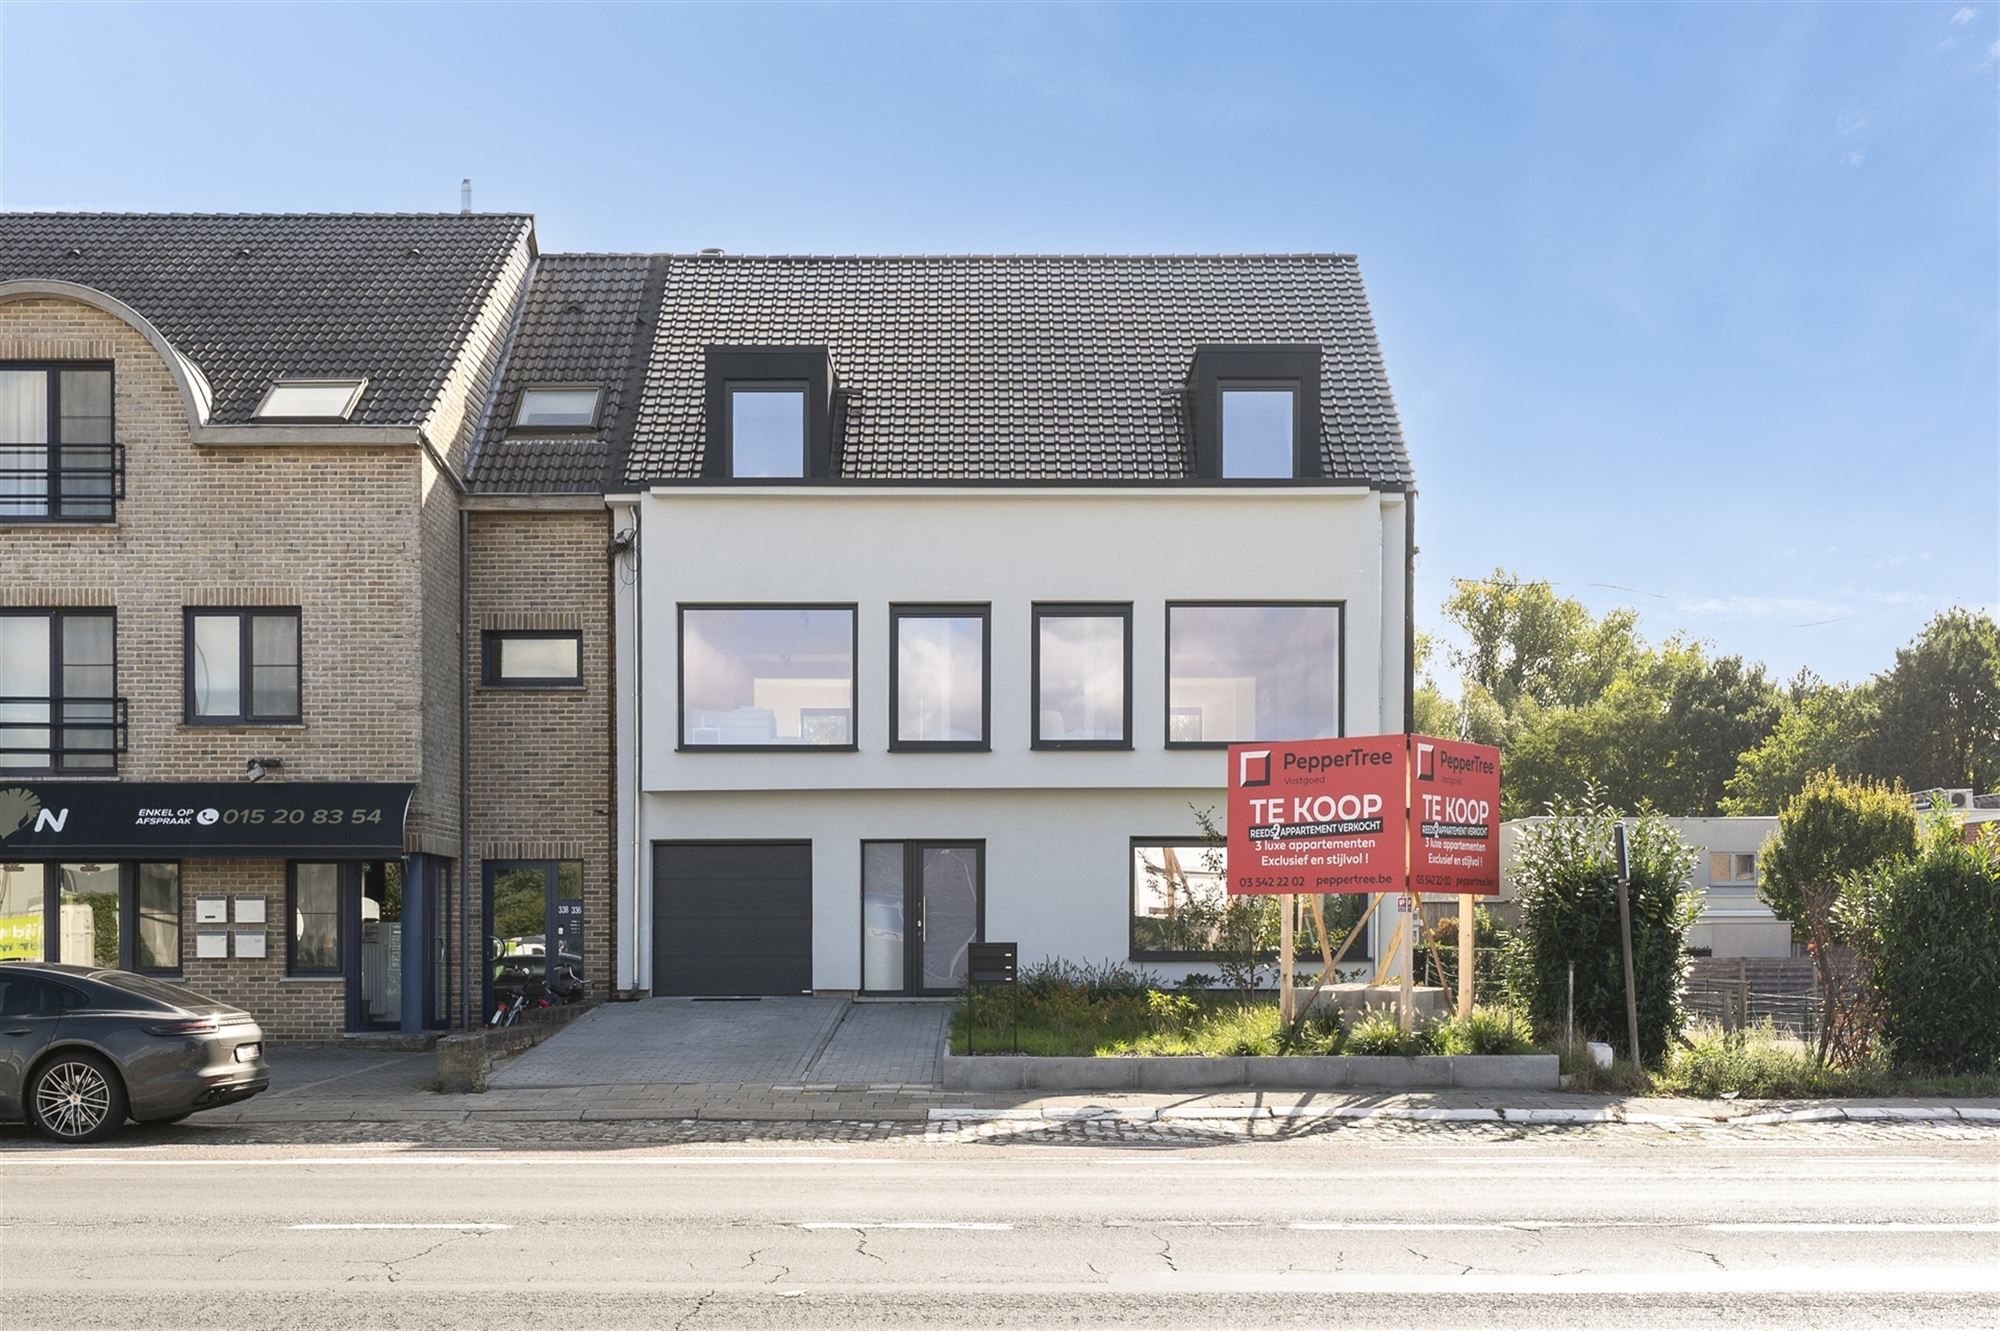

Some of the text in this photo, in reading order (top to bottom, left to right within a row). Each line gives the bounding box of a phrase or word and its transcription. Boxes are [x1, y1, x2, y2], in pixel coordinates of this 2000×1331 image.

[1284, 749, 1393, 773] PepperTree
[1441, 750, 1494, 774] PepperTree
[1284, 776, 1326, 786] Vastgoed
[138, 808, 194, 817] ENKEL OP
[1249, 794, 1383, 824] TE KOOP
[1422, 793, 1489, 825] TE KOOP
[135, 817, 193, 825] AFSPRAAK
[222, 808, 382, 825] 015 20 83 54
[1280, 823, 1337, 837] APPARTEMENT
[1338, 820, 1381, 833] VERKOCHT
[1255, 839, 1376, 852] 3 luxe appartementen
[1425, 837, 1430, 848] 3
[1261, 855, 1309, 867] Exclusief
[1311, 857, 1324, 865] en
[1326, 853, 1362, 867] stijlvol
[1428, 853, 1454, 865] Exclusief
[1454, 857, 1461, 866] en
[1239, 876, 1305, 887] 03 542 22 02
[1316, 873, 1392, 887] peppertree.be
